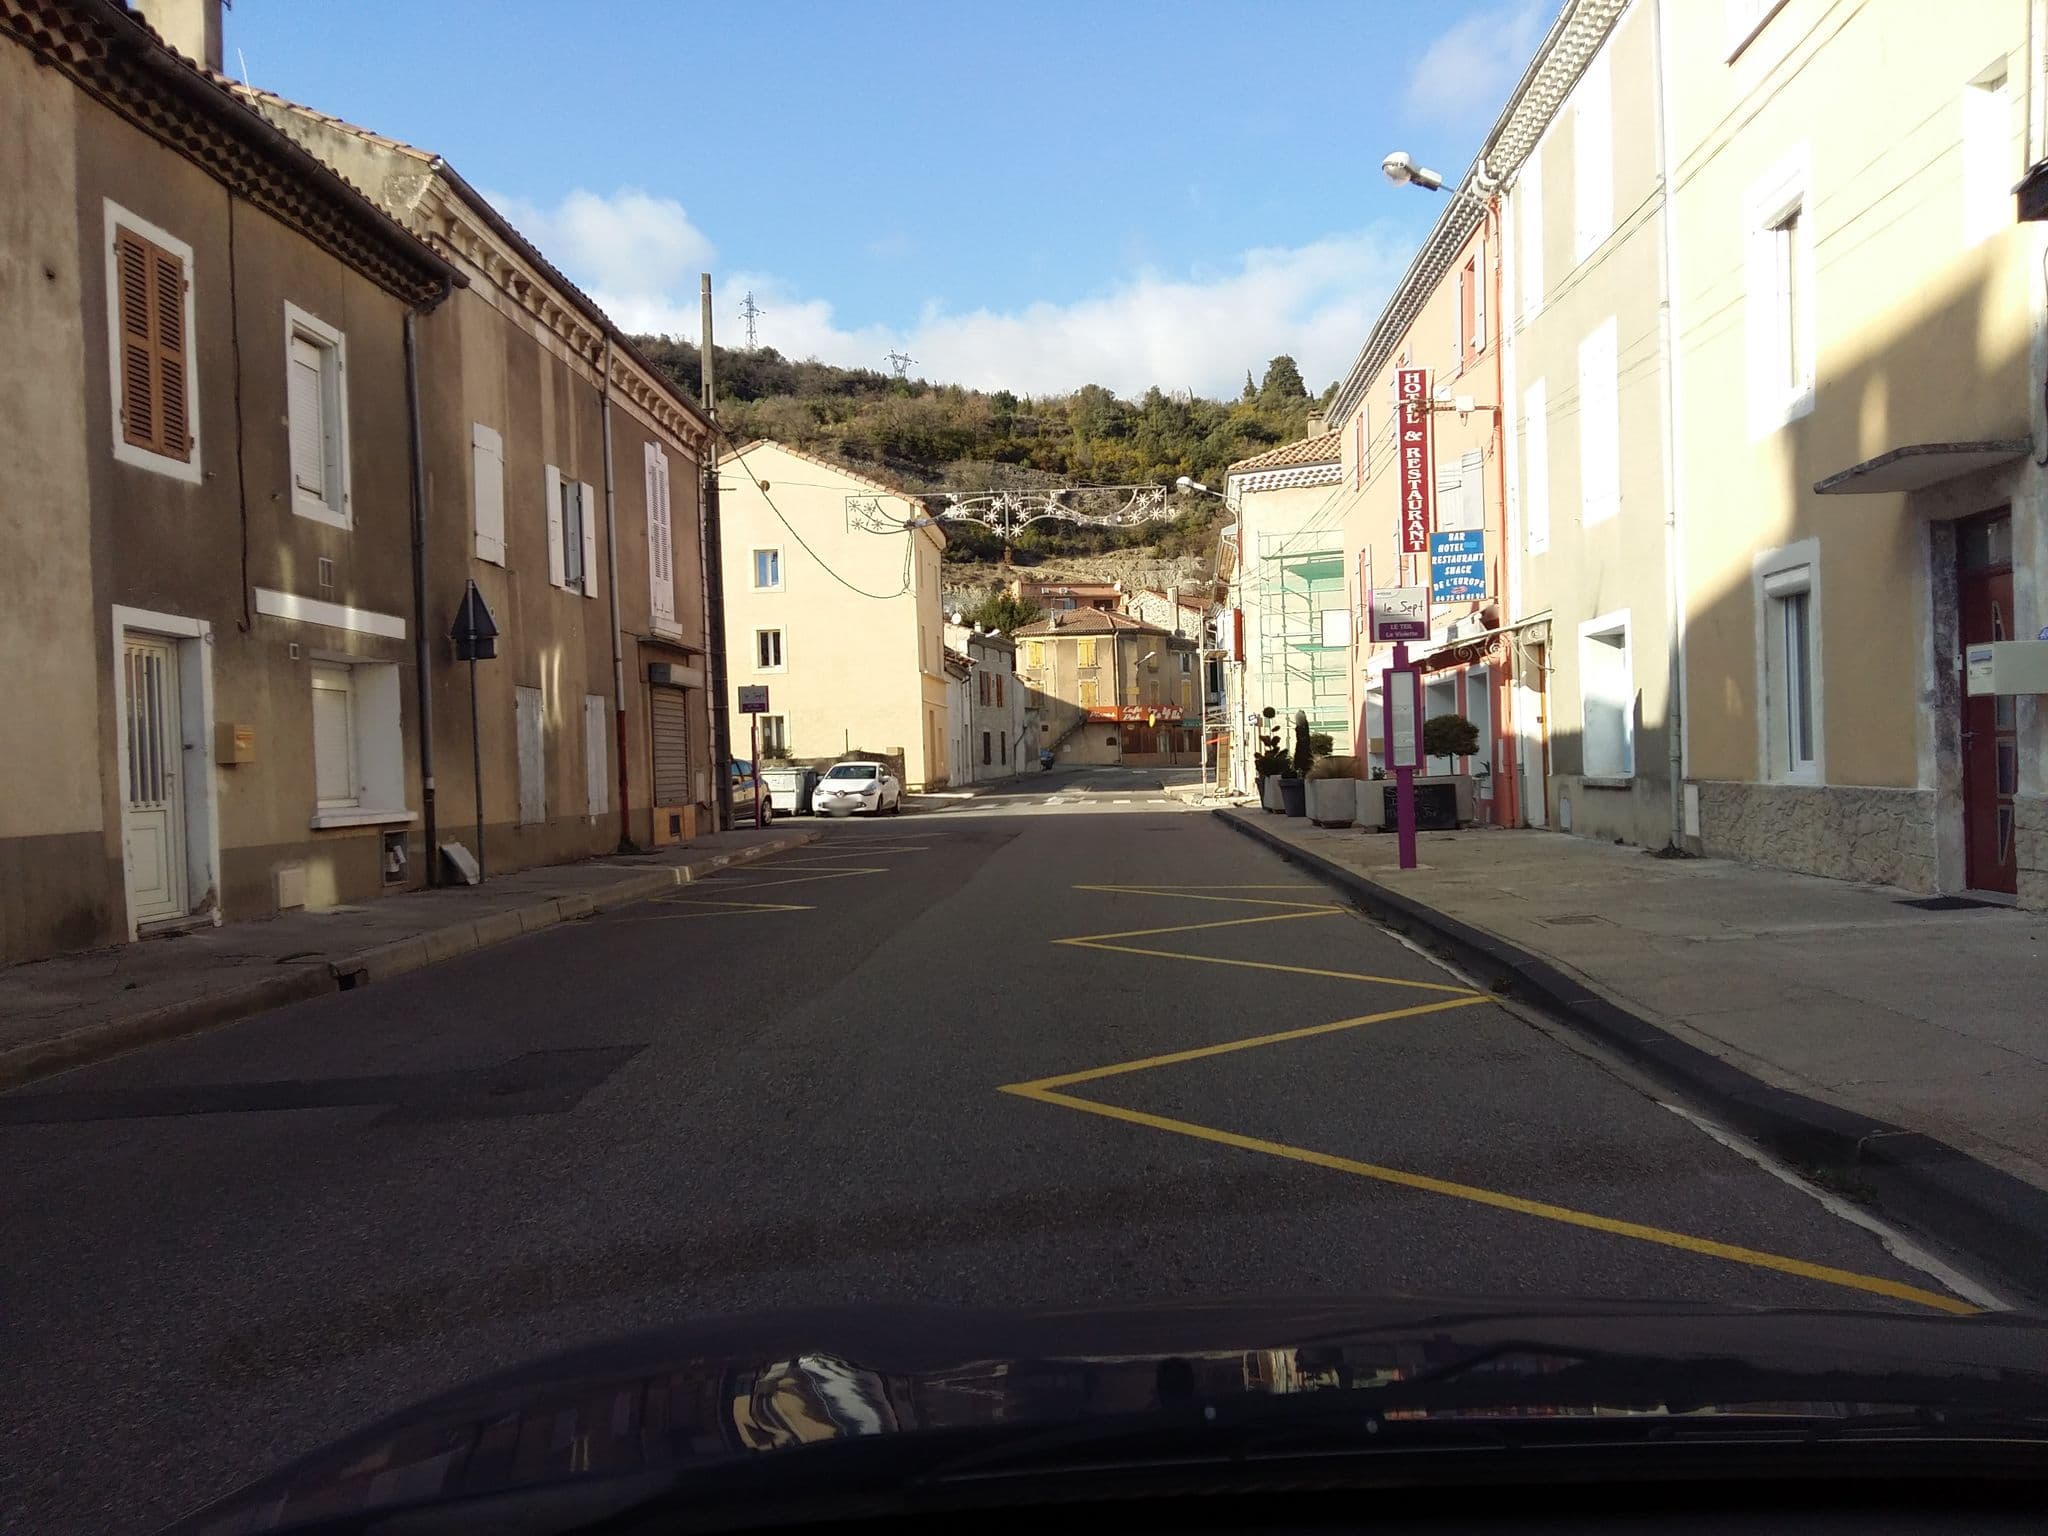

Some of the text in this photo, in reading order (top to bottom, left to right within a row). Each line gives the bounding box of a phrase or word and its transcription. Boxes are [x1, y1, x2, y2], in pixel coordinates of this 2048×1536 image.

[1404, 373, 1424, 550] HOTEL & RESTAURANT
[1448, 532, 1465, 541] BAR
[1437, 543, 1464, 552] HOTEL
[1431, 553, 1484, 565] RESTAURANT
[1433, 580, 1444, 591] DE
[1400, 600, 1424, 617] Sept
